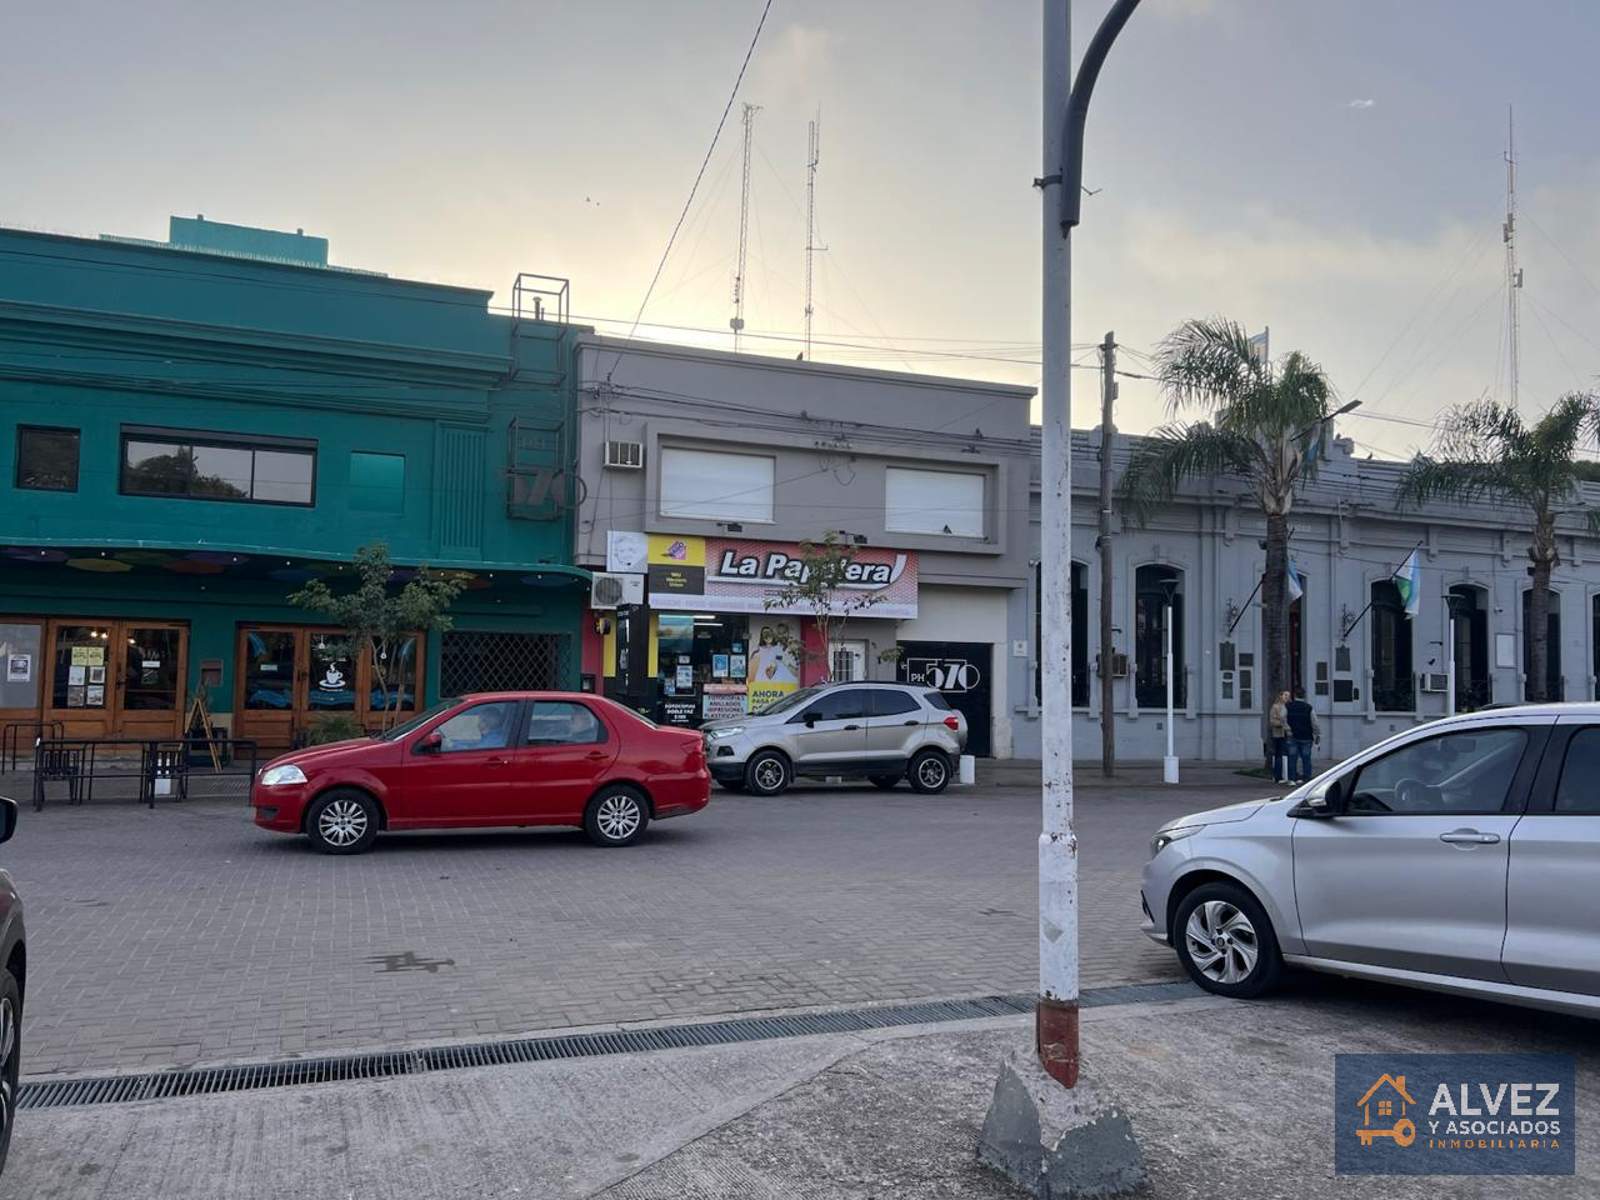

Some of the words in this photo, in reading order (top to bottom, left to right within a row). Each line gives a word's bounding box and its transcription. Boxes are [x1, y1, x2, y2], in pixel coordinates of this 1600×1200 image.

[720, 551, 758, 577] La
[765, 553, 892, 584] Papera
[911, 674, 925, 682] PH
[926, 660, 980, 690] 570
